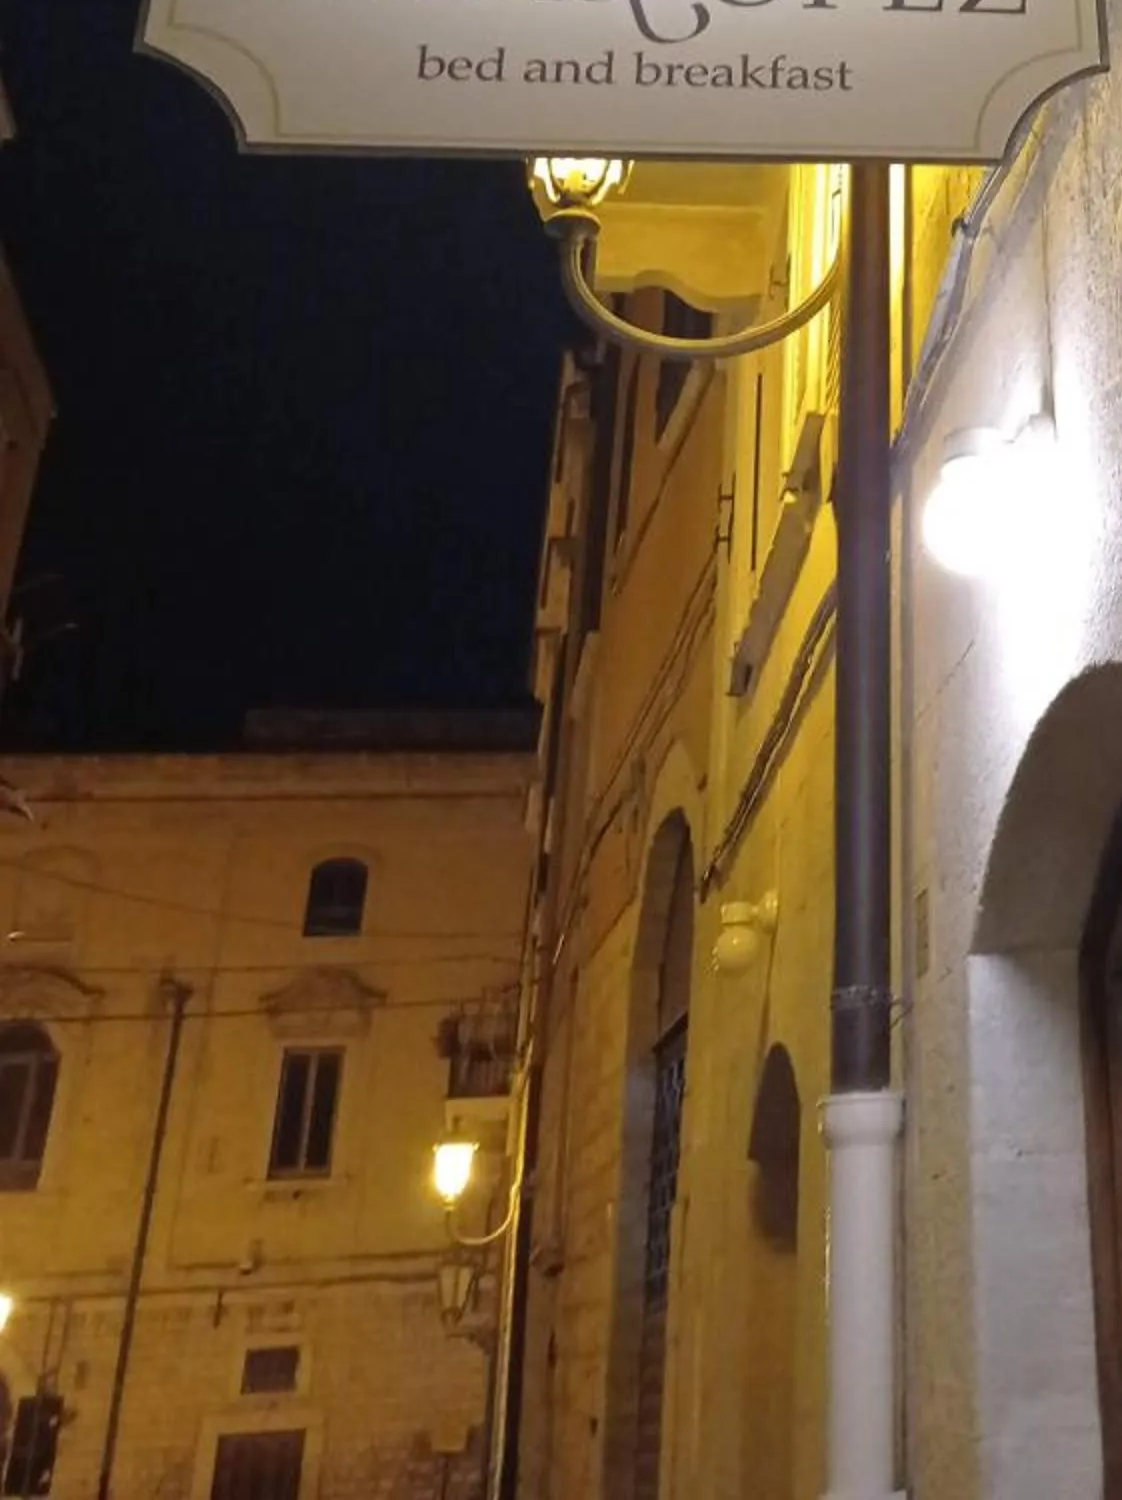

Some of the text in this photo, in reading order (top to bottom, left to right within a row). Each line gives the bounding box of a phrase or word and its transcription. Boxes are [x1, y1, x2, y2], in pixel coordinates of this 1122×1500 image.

[416, 43, 854, 93] bed and breakfast
